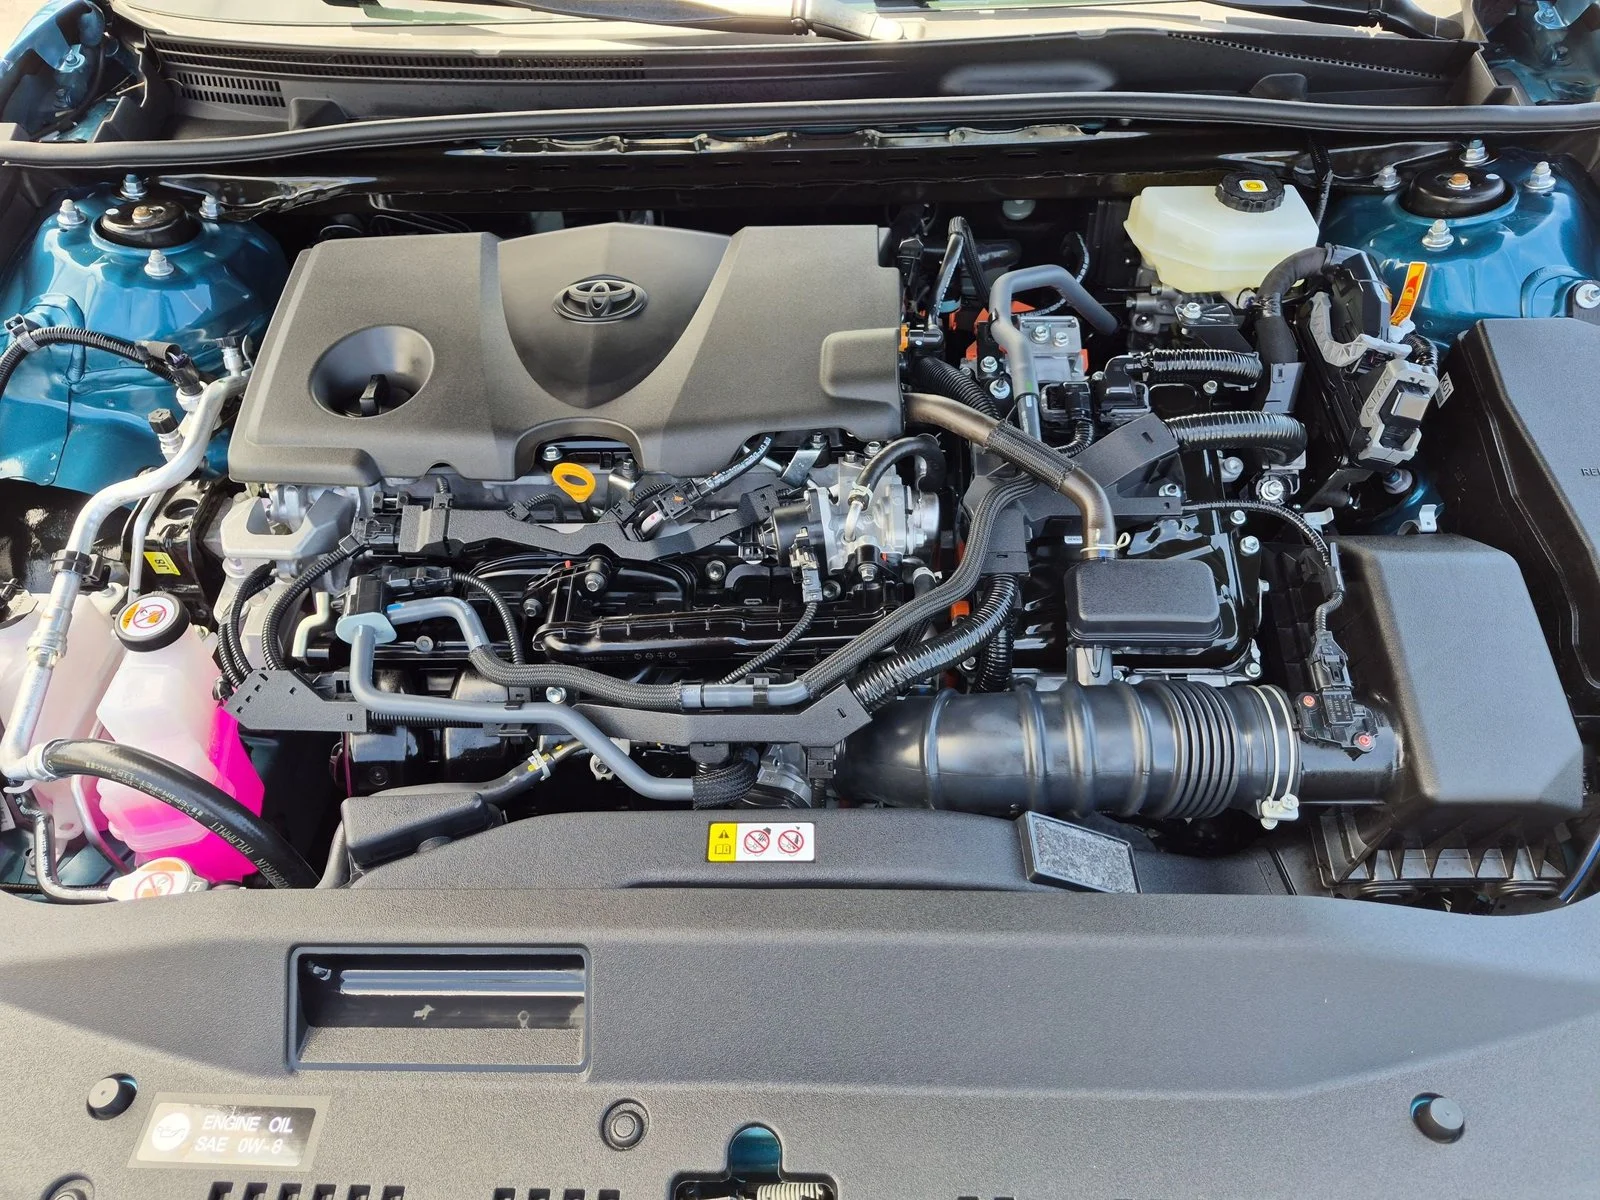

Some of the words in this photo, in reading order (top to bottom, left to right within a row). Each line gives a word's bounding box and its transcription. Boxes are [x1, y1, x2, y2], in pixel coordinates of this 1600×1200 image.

[208, 821, 255, 856] HYLAMMIT
[202, 1115, 262, 1133] ENGINE
[268, 1116, 293, 1134] OIL
[194, 1136, 229, 1153] SAE
[237, 1138, 284, 1155] 0W-8
